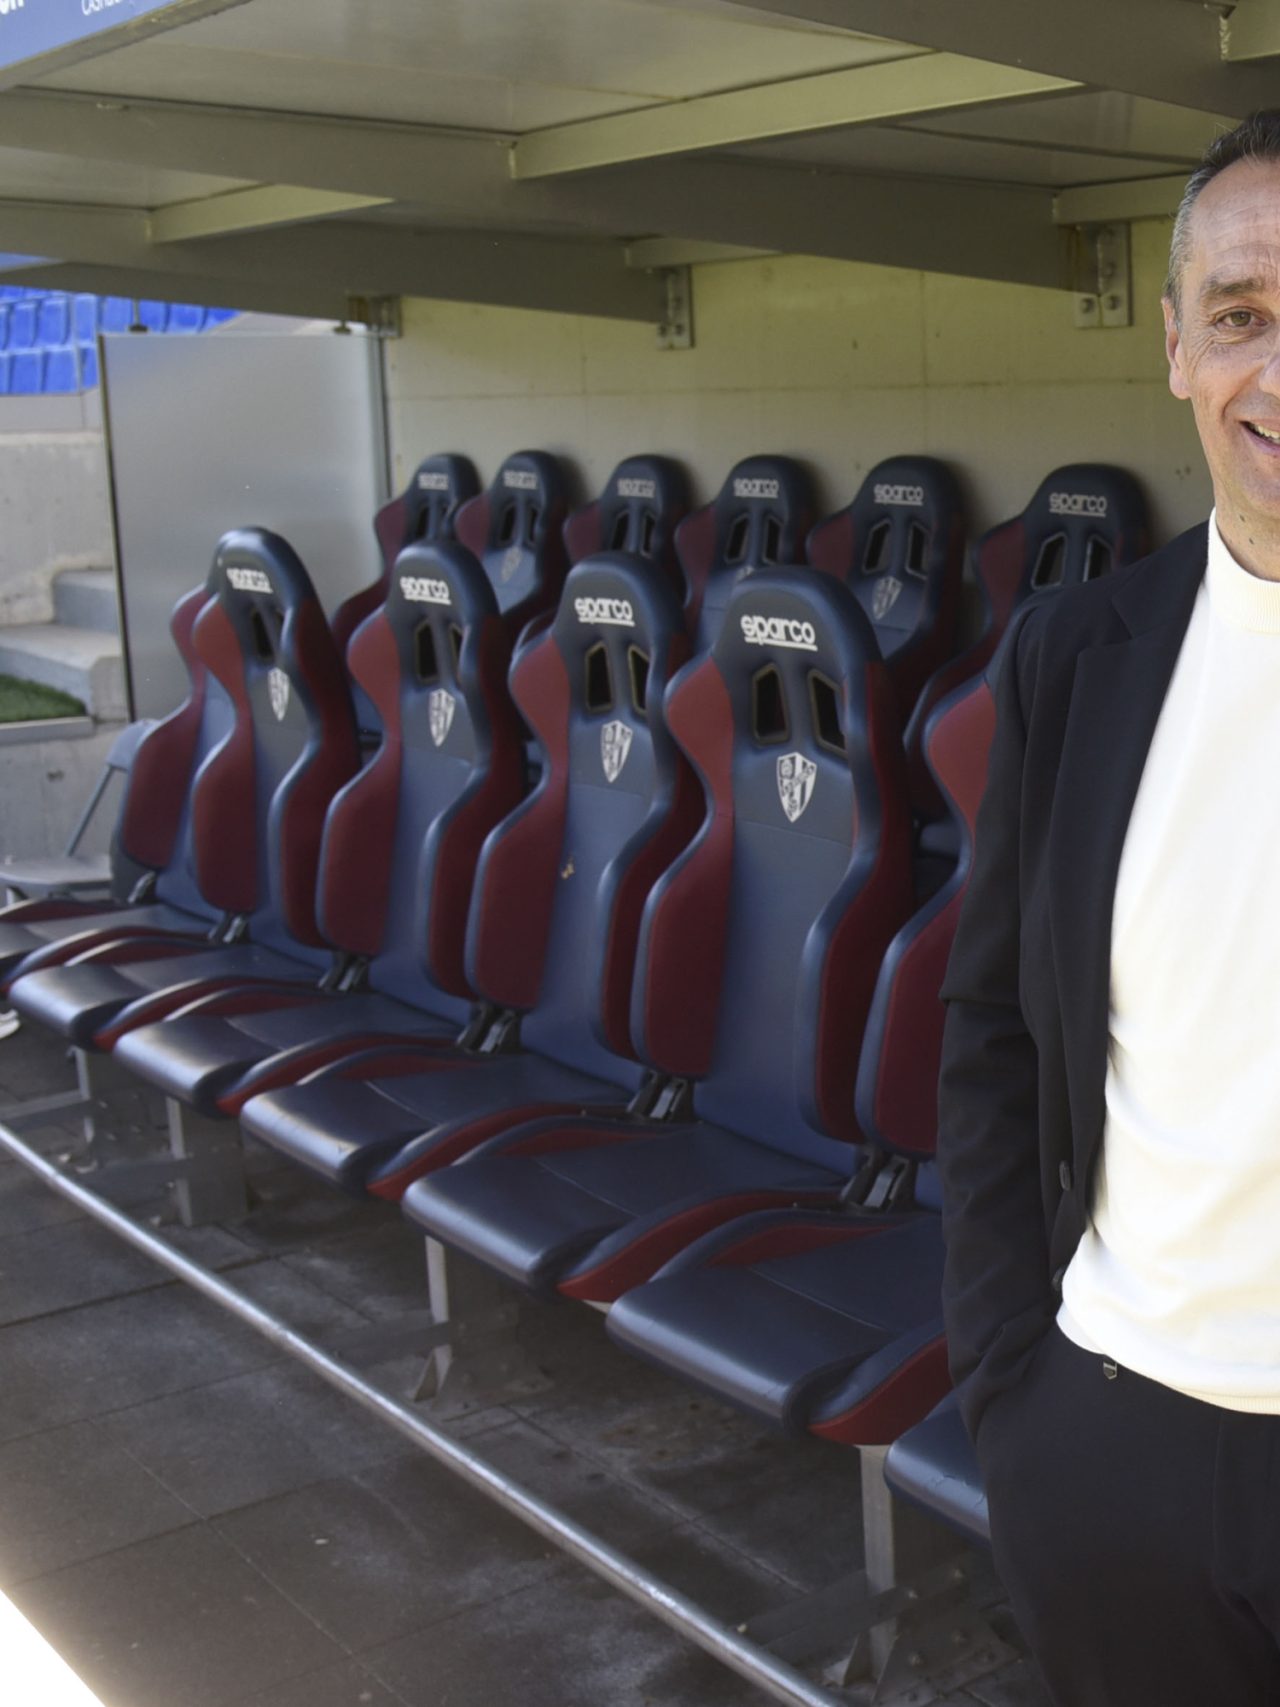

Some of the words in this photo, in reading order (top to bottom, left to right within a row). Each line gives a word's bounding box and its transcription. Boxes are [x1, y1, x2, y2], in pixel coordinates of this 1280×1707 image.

[874, 484, 923, 506] sparco
[1049, 493, 1107, 517] sparco
[574, 598, 636, 627] sparco
[740, 615, 818, 651] sparco
